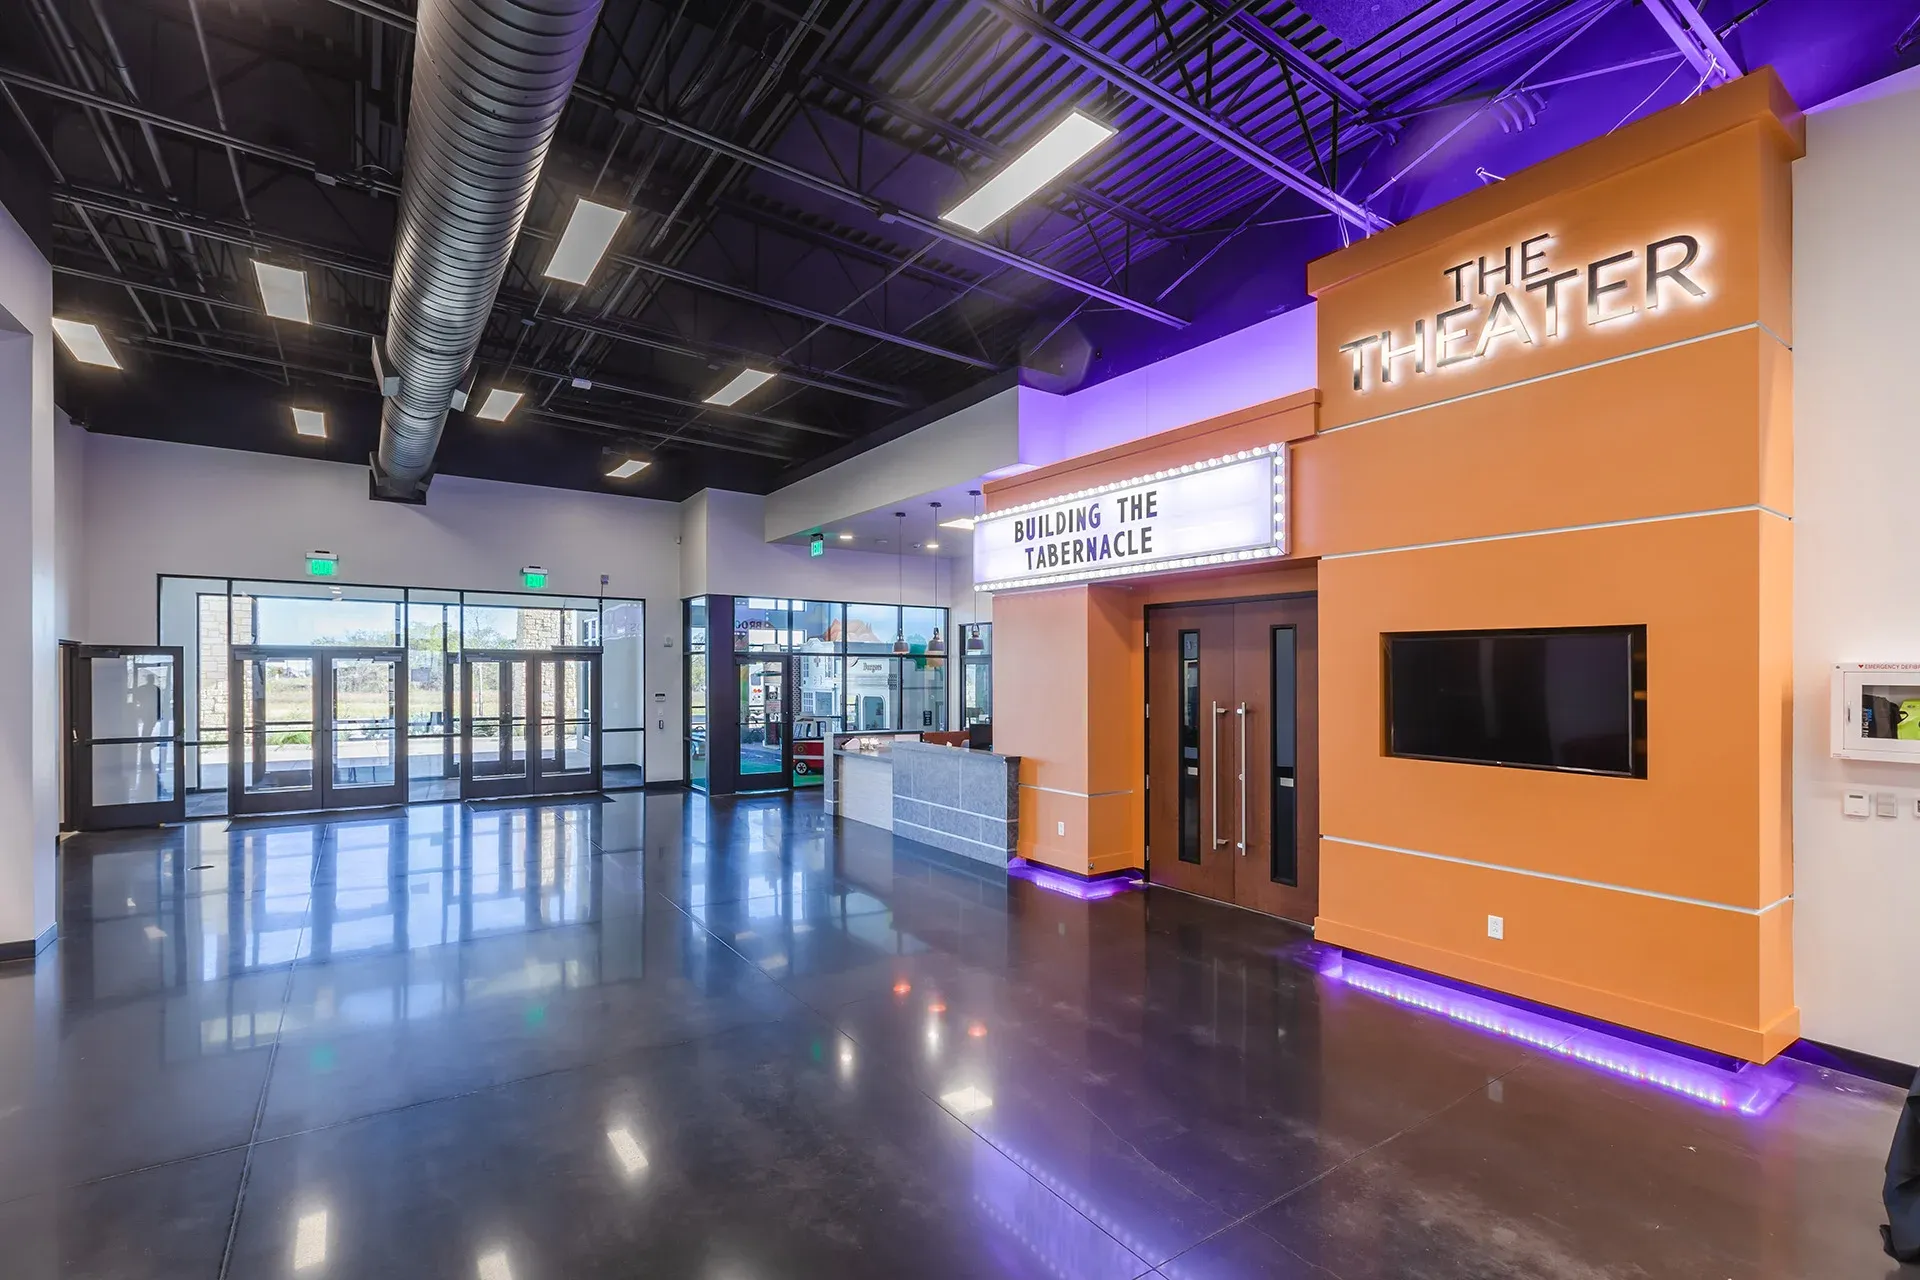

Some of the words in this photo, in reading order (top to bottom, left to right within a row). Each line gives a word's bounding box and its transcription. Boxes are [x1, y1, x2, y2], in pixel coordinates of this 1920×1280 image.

[1443, 232, 1551, 303] THE
[1339, 234, 1707, 391] THEATER
[1014, 503, 1101, 543] BUILDING
[1117, 490, 1158, 523] THE
[1025, 526, 1153, 570] TABERNACLE
